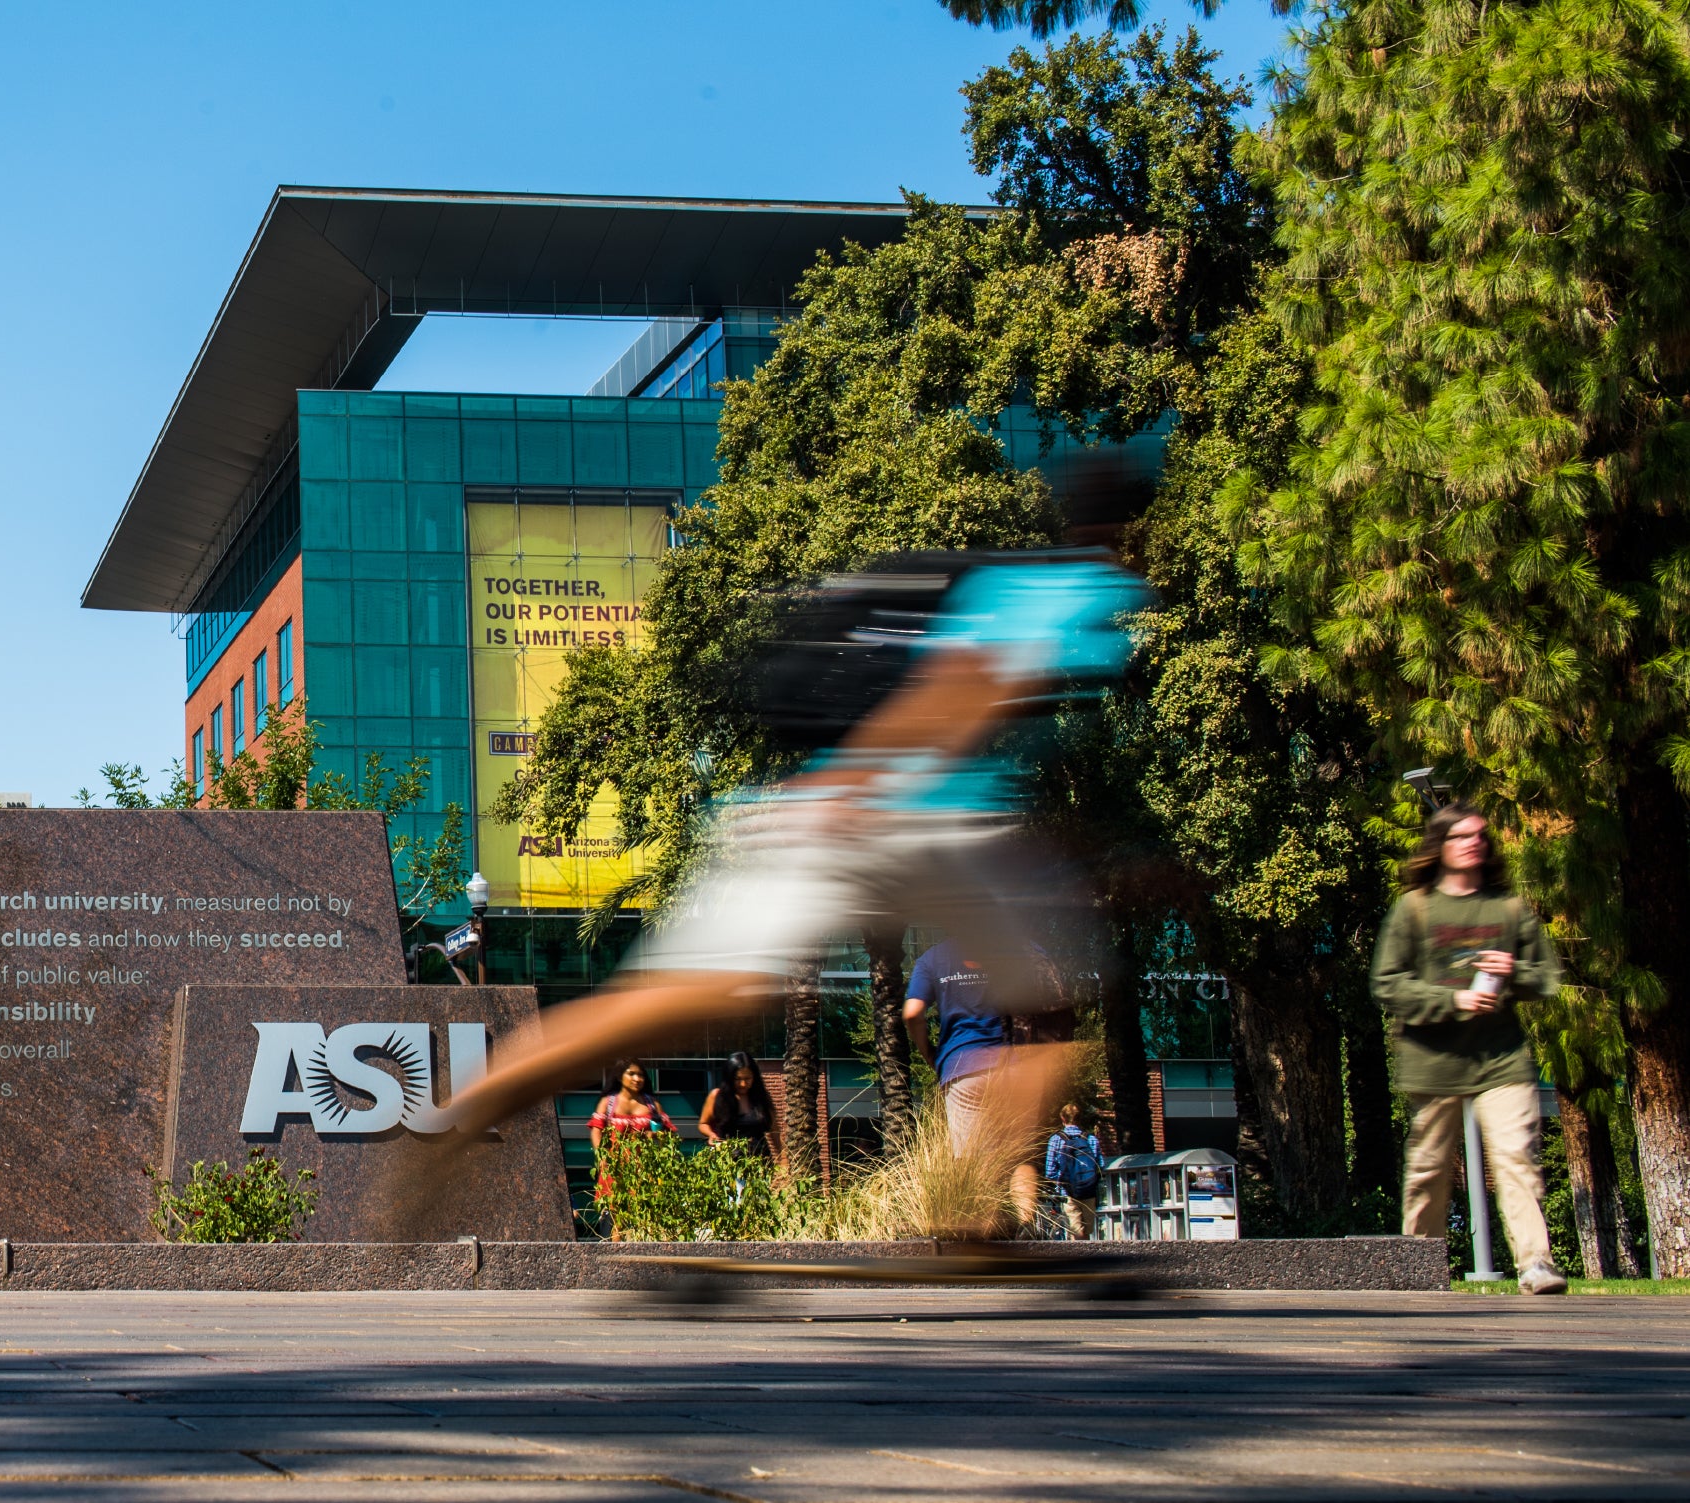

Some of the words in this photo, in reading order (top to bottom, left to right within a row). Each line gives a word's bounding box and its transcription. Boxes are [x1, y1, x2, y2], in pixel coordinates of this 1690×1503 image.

[484, 577, 605, 600] TOGETHER,
[485, 603, 531, 620] OUR
[539, 604, 641, 622] POTENTIA
[486, 628, 507, 645] IS
[514, 629, 626, 648] LIMITLESS
[570, 837, 609, 847] Arizona
[568, 848, 621, 860] University
[45, 891, 168, 915] university,
[176, 892, 280, 911] measured
[288, 894, 321, 911] not
[328, 894, 352, 916] by
[88, 929, 128, 947] and
[135, 929, 180, 947] how
[188, 929, 233, 953] they
[240, 930, 350, 951] succeed;
[16, 965, 80, 989] public
[88, 966, 150, 987] value;
[0, 1040, 71, 1060] overall
[239, 1022, 499, 1134] ASU
